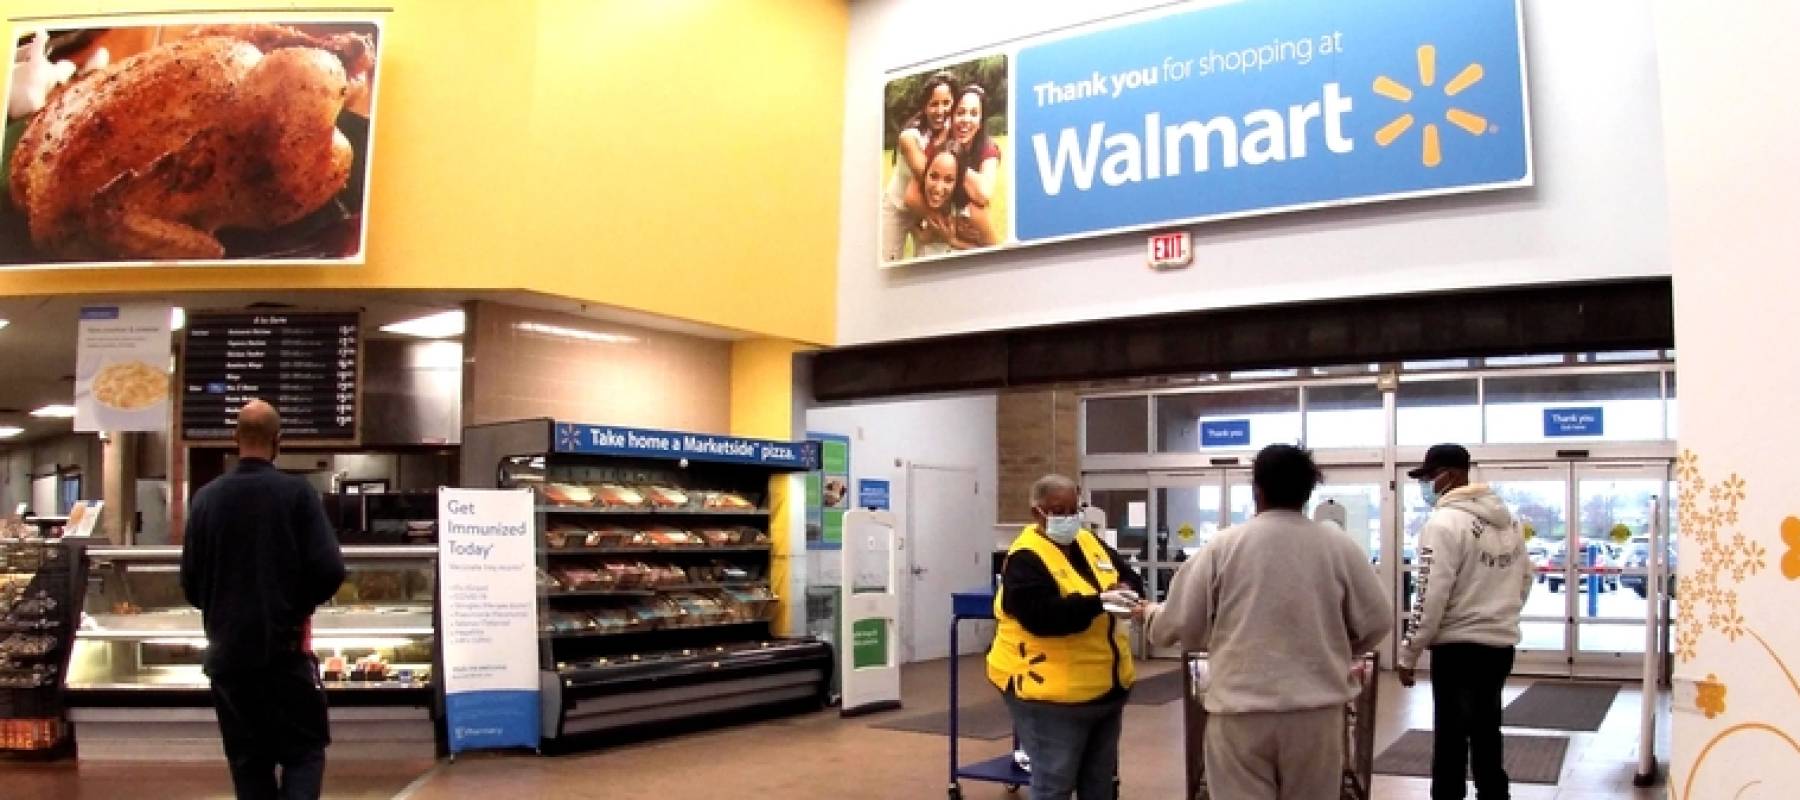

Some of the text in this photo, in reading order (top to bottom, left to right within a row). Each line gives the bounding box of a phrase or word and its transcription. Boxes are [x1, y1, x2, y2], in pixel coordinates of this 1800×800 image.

[1033, 30, 1344, 107] Thank you for shopping at
[1031, 81, 1355, 196] Walmart
[1153, 234, 1182, 261] EXIT
[1552, 413, 1595, 425] Thank you
[589, 427, 625, 448] Take
[628, 431, 670, 451] home
[671, 437, 680, 451] a
[760, 444, 796, 463] pizza.
[447, 499, 476, 515] Get
[447, 519, 528, 536] Immunized
